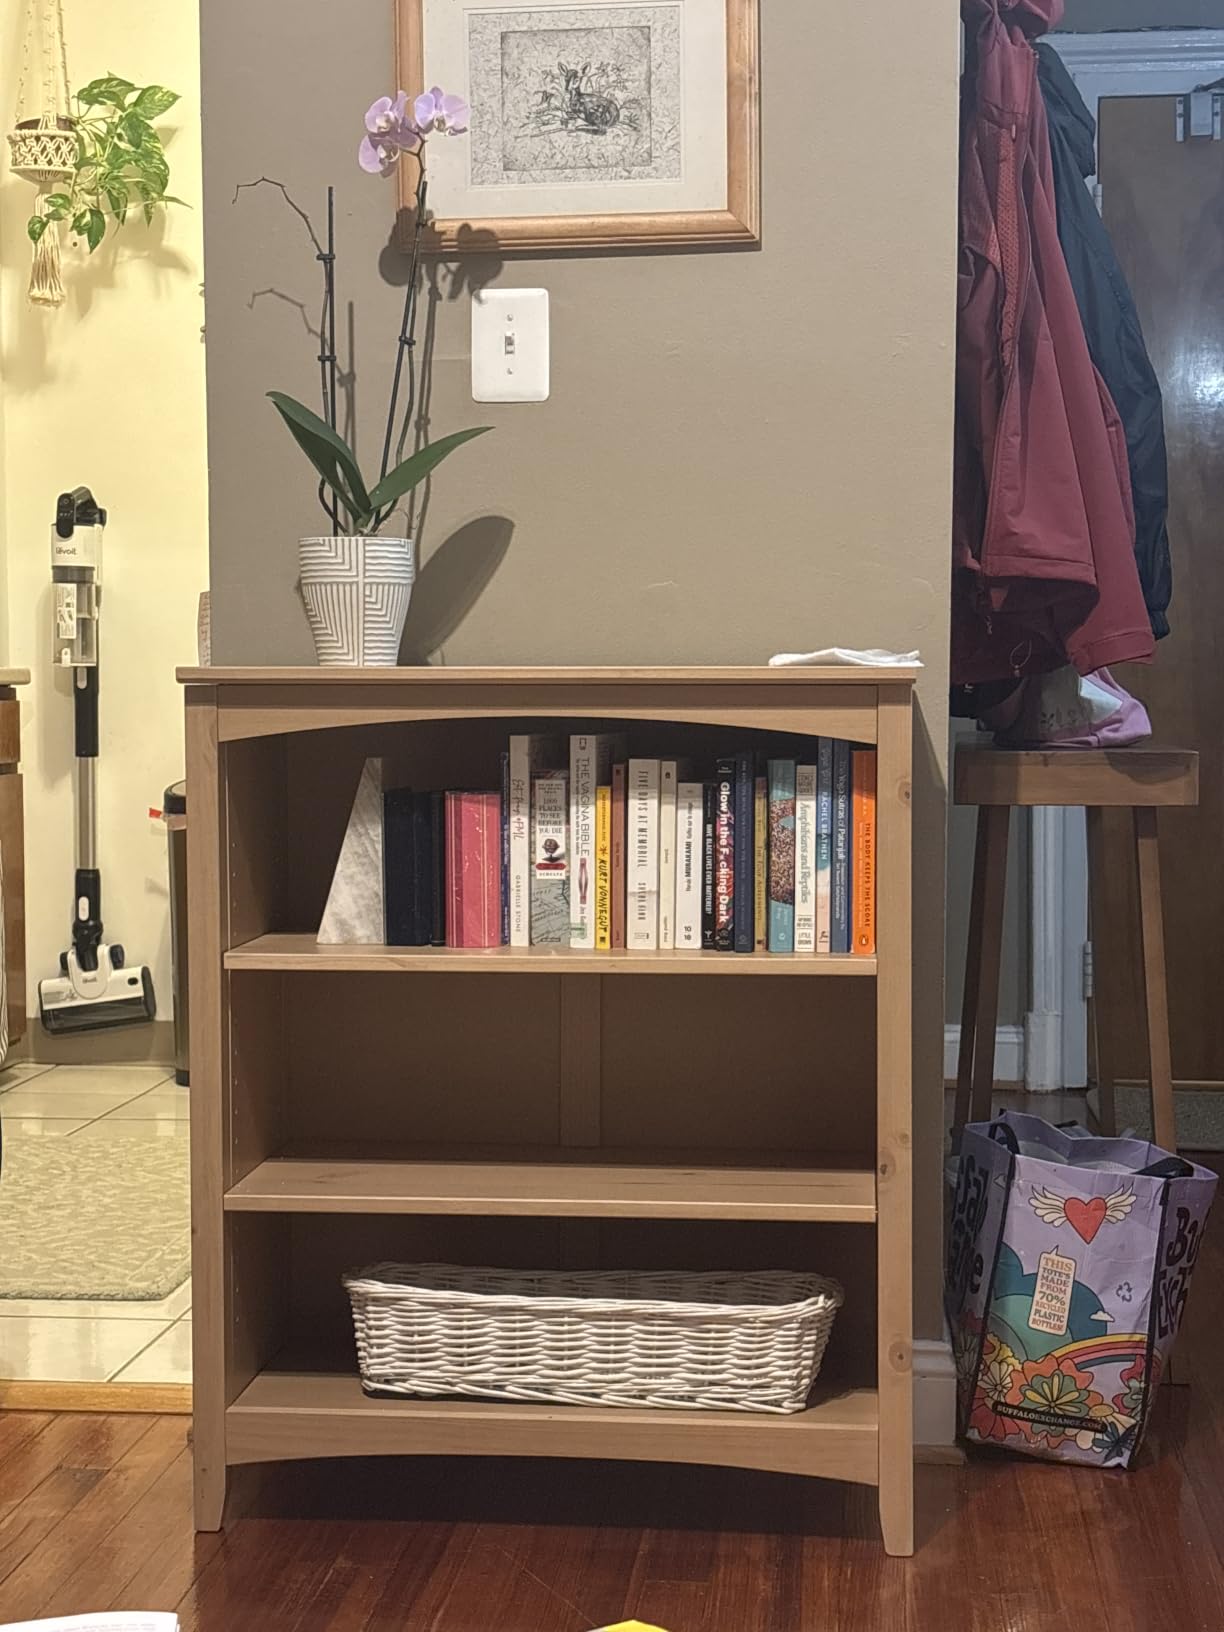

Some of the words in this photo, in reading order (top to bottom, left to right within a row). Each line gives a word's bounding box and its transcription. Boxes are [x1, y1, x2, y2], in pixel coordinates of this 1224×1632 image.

[580, 757, 591, 780] THE
[637, 770, 649, 788] FIVE
[580, 781, 591, 822] VAGINA
[637, 791, 649, 812] DAYS
[719, 782, 730, 812] Glow
[820, 791, 829, 823] RACHEL
[637, 815, 648, 824] AT
[719, 814, 731, 826] in
[797, 802, 812, 853] Amphibians
[580, 823, 591, 857] BIBLE
[705, 823, 713, 837] HAVE
[719, 827, 731, 847] the
[864, 823, 872, 837] THE
[637, 827, 648, 868] MEMORIAL
[705, 838, 713, 855] BLACK
[820, 823, 829, 860] BRATHEN
[864, 839, 872, 859] BODY
[684, 841, 693, 878] MURAKAMI
[705, 855, 713, 870] LIVES
[800, 853, 811, 870] and
[598, 858, 608, 884] KURT
[705, 871, 713, 885] EVER
[864, 862, 872, 884] KEEPS
[798, 871, 812, 904] Reptiles
[864, 887, 872, 900] THE
[597, 885, 609, 933] VONNEGUT
[719, 895, 730, 923] Dark
[864, 903, 872, 928] SCORE
[1042, 1267, 1071, 1279] TOTE'S
[1043, 1257, 1073, 1273] THIS
[1040, 1274, 1070, 1288] MADE
[1040, 1282, 1067, 1296] FROM
[1035, 1300, 1066, 1314] RECYCLED
[1038, 1290, 1066, 1306] 70%
[1034, 1308, 1065, 1323] PLASTIC
[996, 1404, 1102, 1430] BUFFALOEXCHANGE.COM
